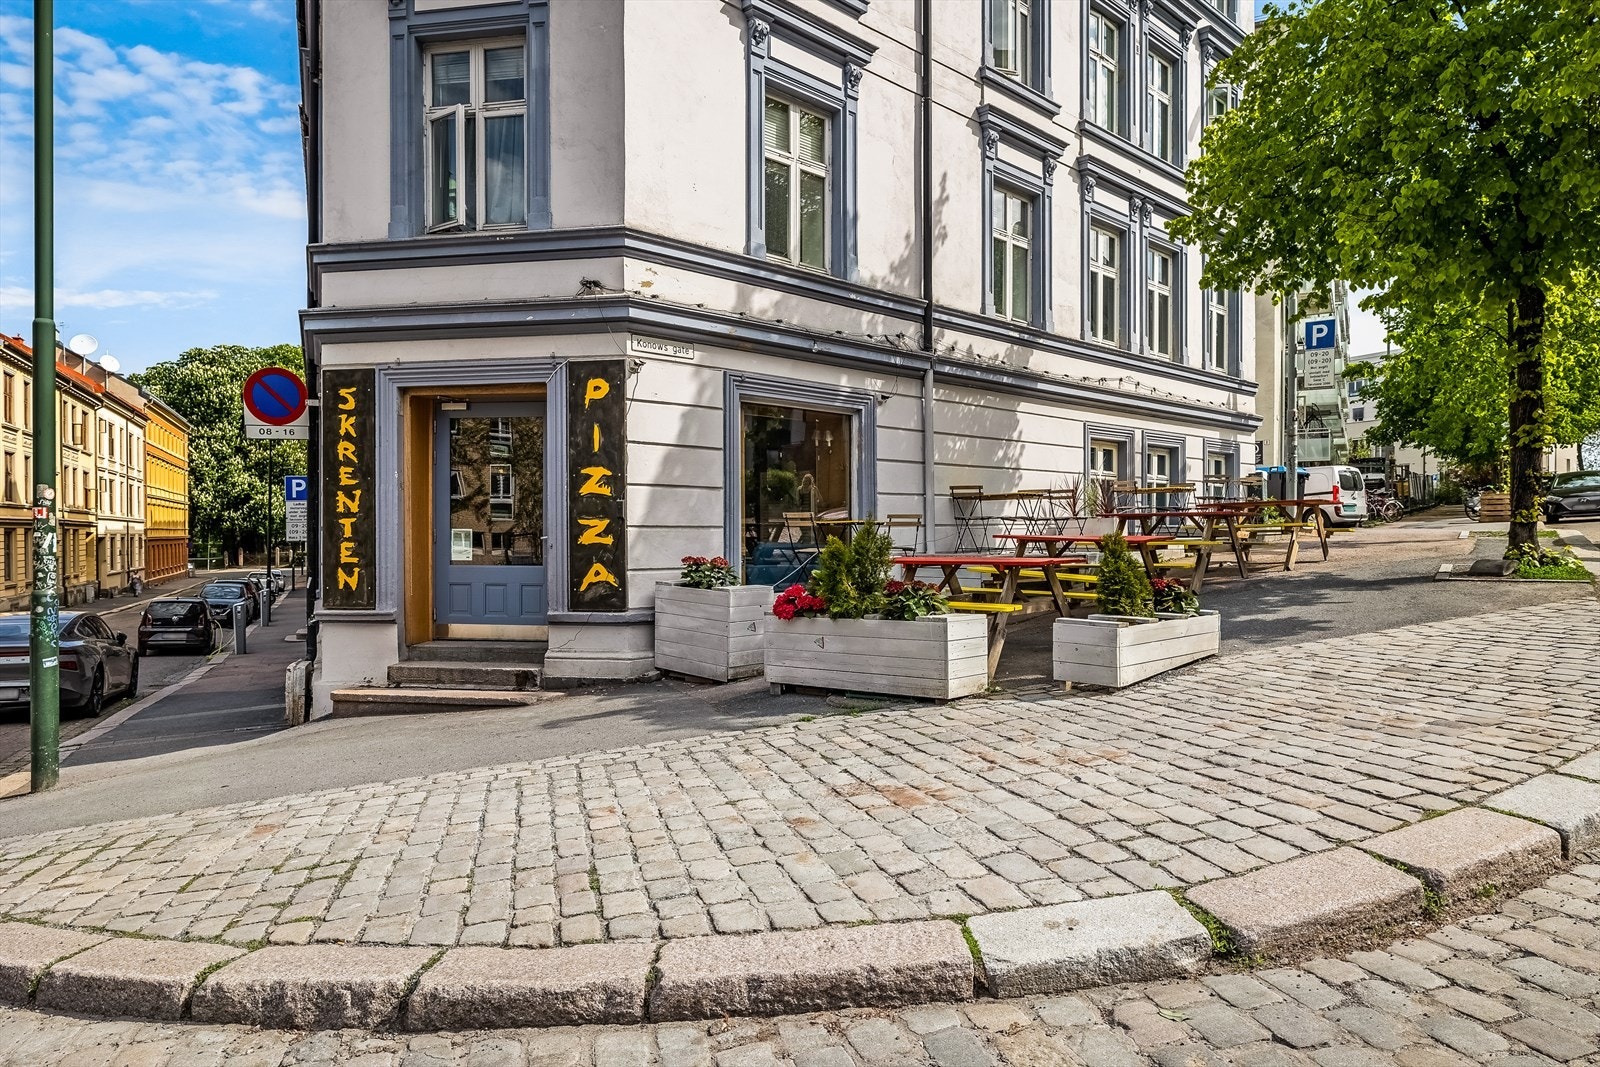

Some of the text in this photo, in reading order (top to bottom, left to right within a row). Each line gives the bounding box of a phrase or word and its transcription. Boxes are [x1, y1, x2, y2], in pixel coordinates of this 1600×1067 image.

[1312, 324, 1328, 346] P
[636, 338, 690, 355] Konows gate
[258, 428, 272, 436] 08
[283, 428, 295, 436] 16
[292, 479, 306, 498] P
[336, 387, 362, 591] SKRENTEN
[577, 378, 618, 592] PIZZA
